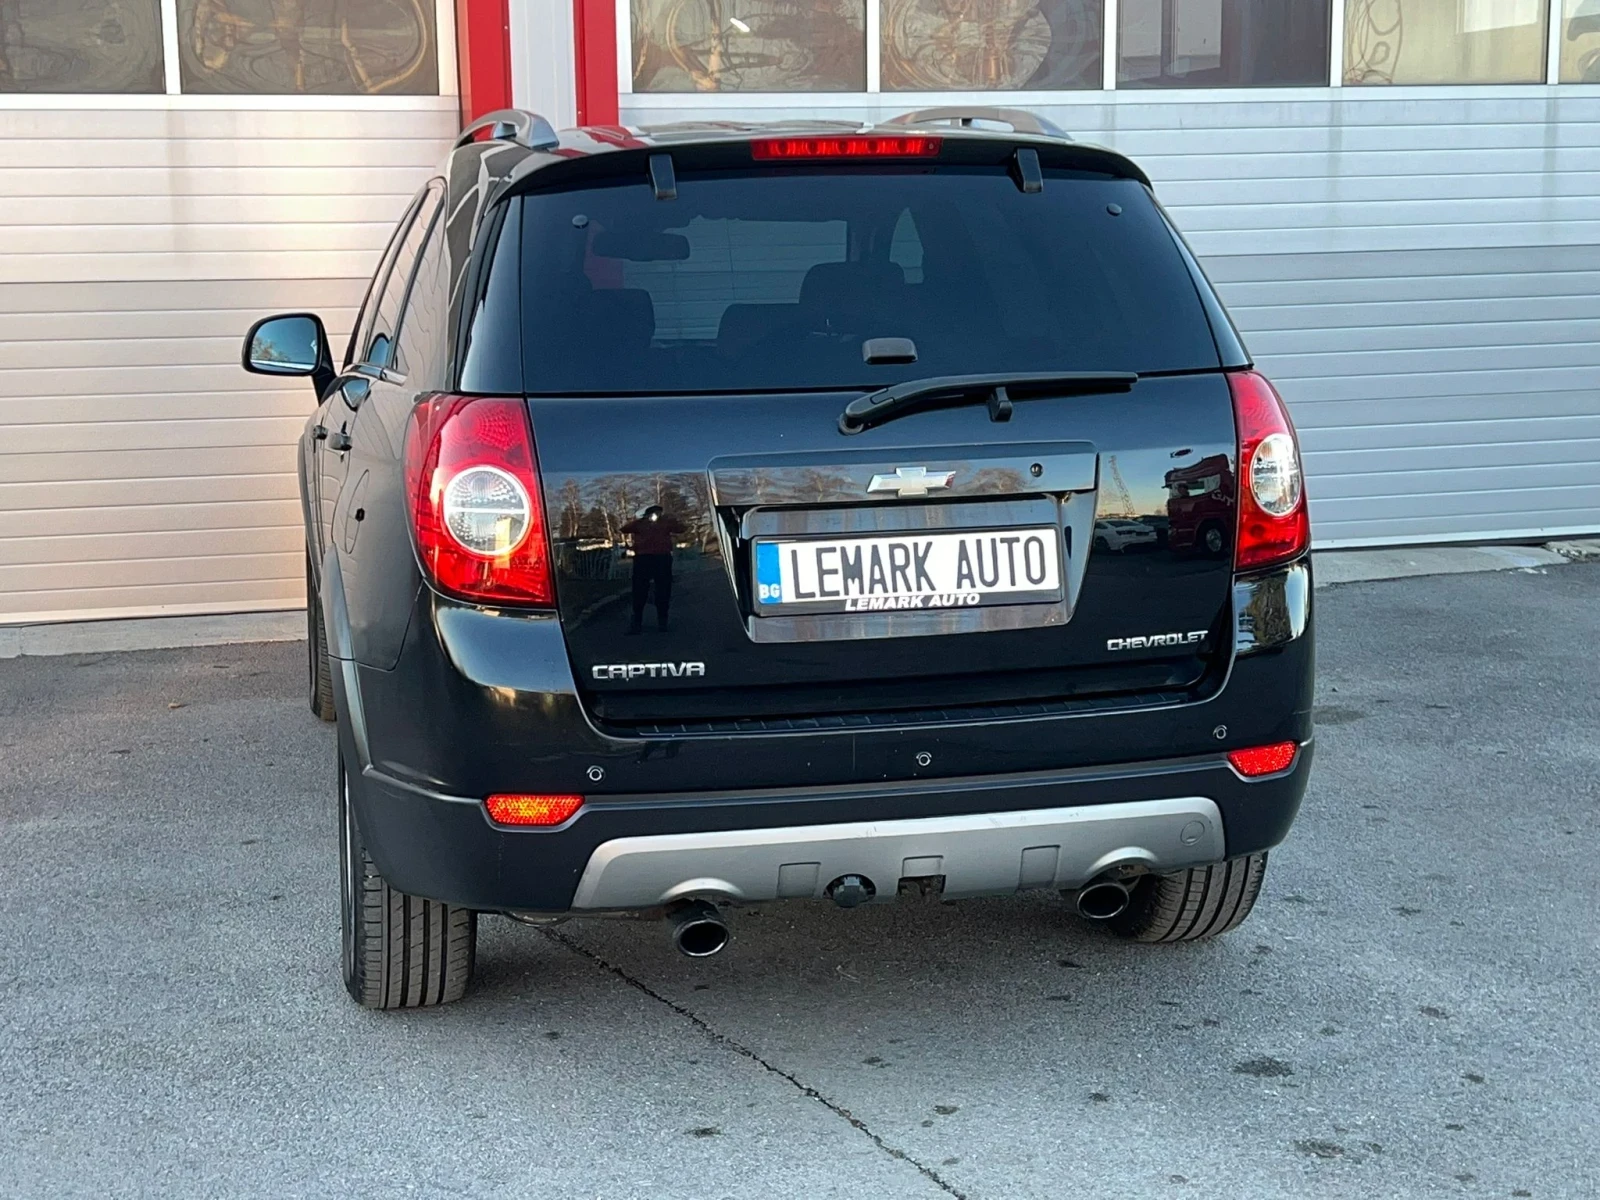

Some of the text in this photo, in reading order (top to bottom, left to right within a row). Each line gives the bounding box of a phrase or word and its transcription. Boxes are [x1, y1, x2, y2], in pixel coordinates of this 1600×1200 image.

[790, 535, 1046, 599] LEMARK AUTO
[759, 583, 780, 599] BG
[844, 592, 981, 612] LEMARK AUTO
[1107, 630, 1209, 651] CHEVROLET
[592, 661, 705, 679] CAPTIVA
